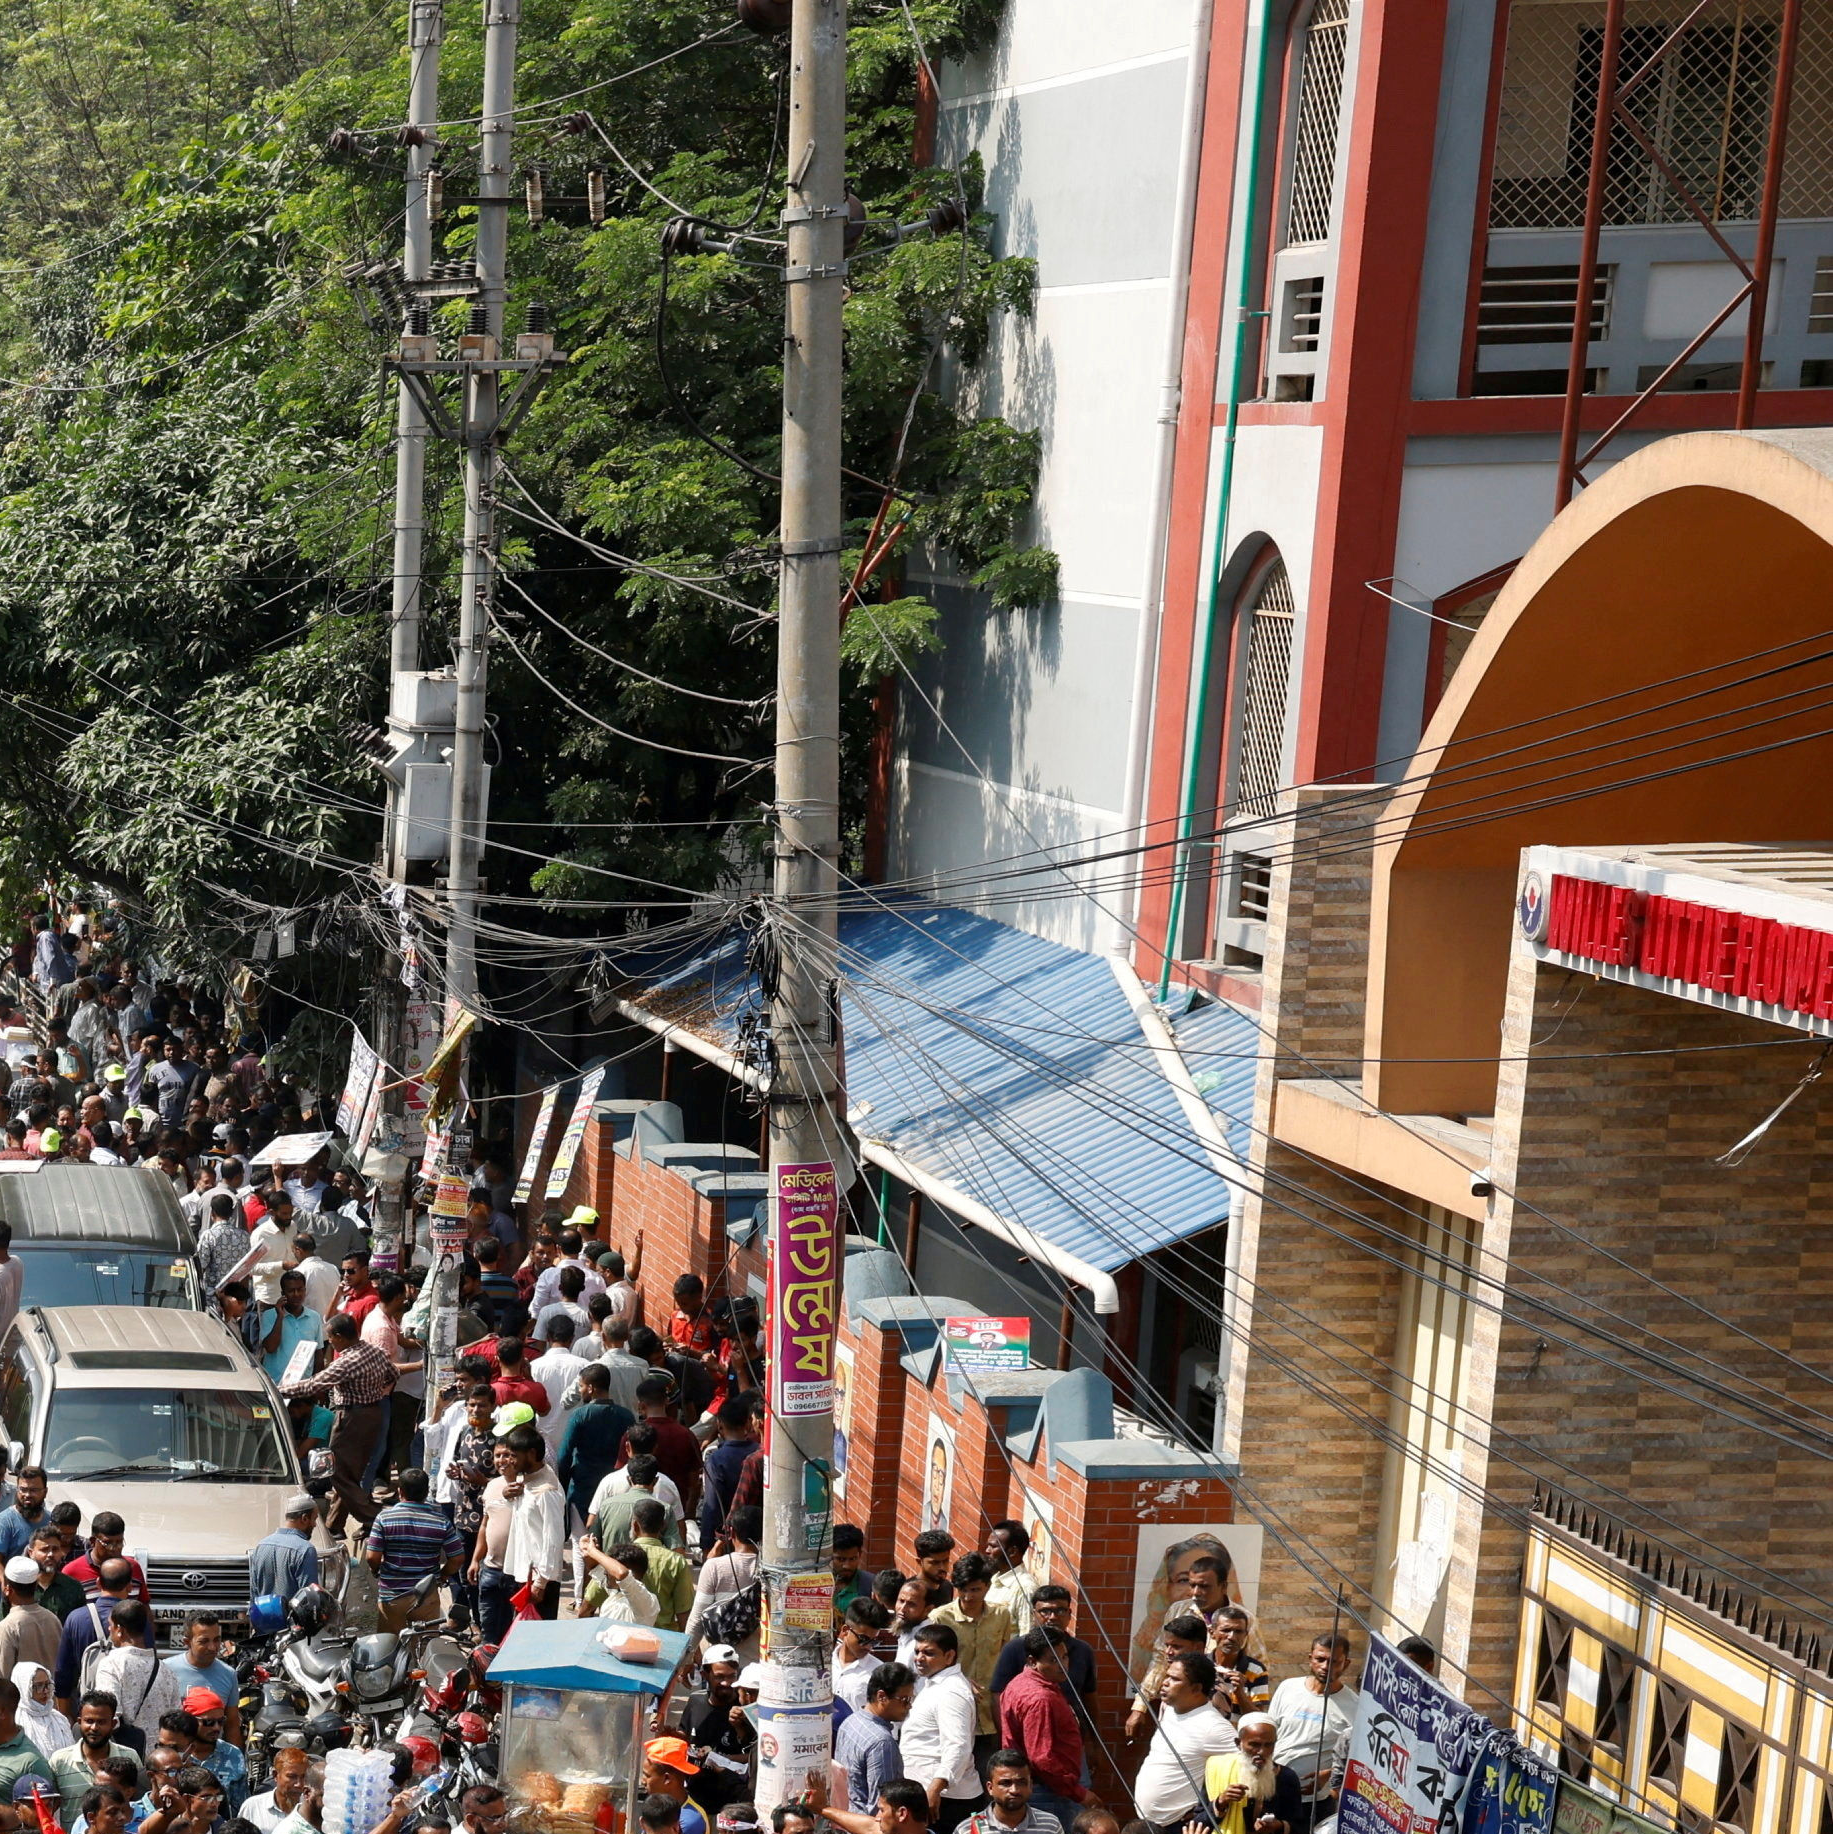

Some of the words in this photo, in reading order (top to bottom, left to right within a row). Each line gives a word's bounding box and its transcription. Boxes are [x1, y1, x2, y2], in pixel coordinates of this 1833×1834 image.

[1733, 914, 1833, 1021] FLOWE
[781, 1169, 834, 1188] মেডিকেল
[783, 1214, 835, 1377] উন্মেষ
[787, 1389, 813, 1401] ডাবল
[156, 1609, 185, 1619] LAND
